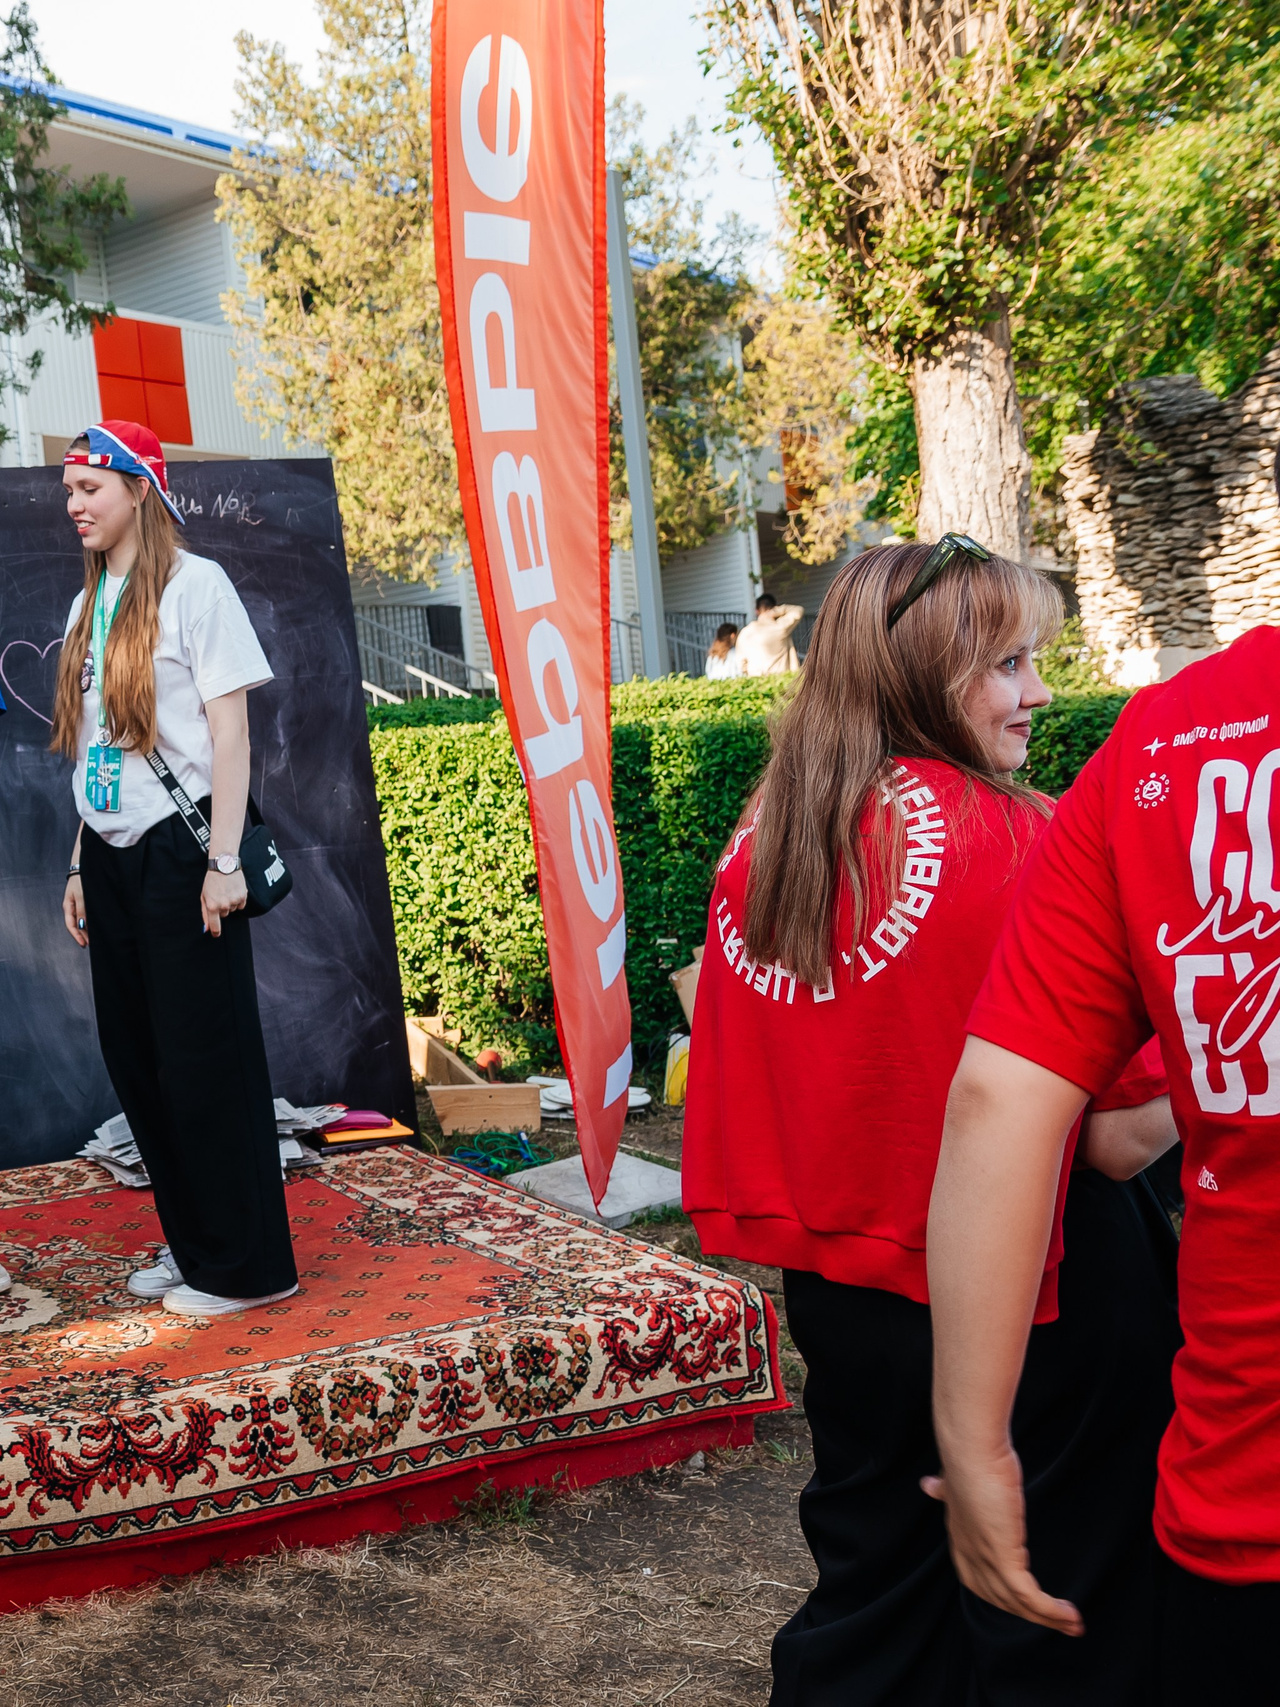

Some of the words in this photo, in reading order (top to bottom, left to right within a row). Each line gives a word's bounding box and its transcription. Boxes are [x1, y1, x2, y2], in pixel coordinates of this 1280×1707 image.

[1209, 727, 1218, 740] с
[1219, 714, 1269, 742] форумом
[171, 786, 195, 816] PUMA
